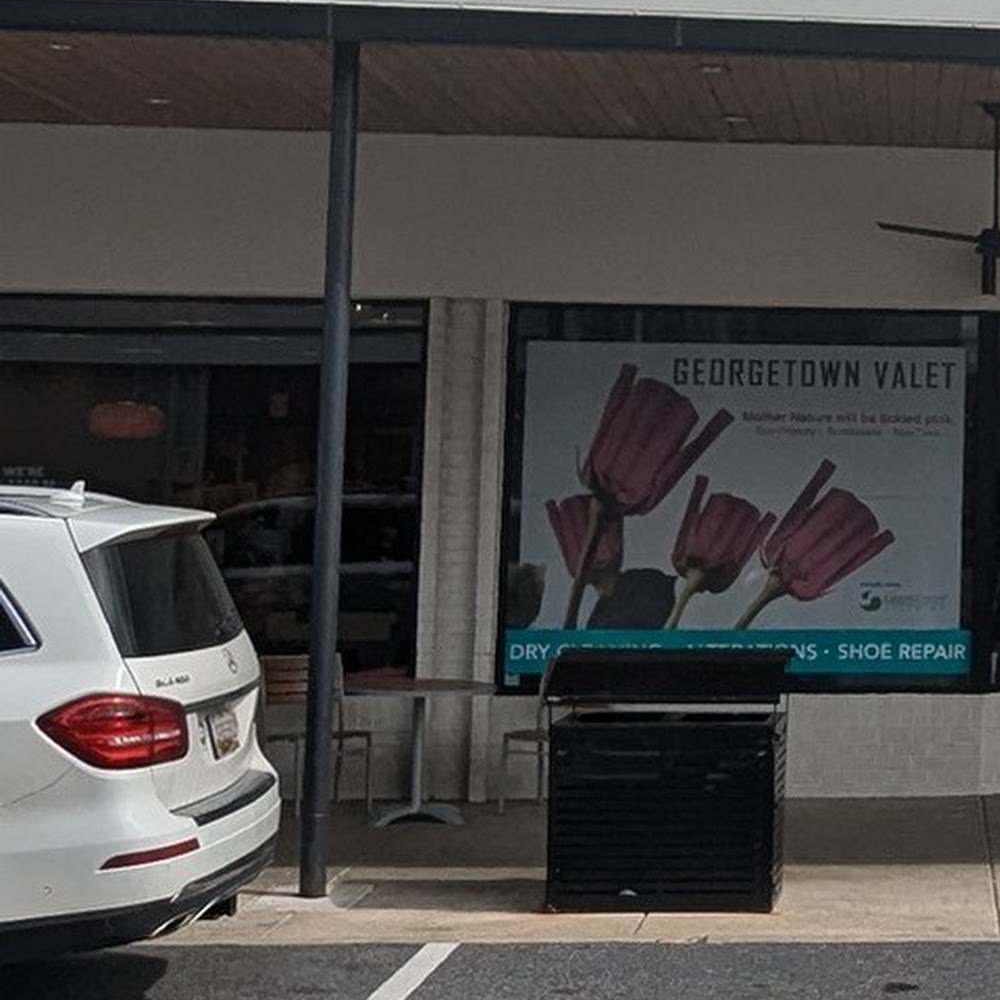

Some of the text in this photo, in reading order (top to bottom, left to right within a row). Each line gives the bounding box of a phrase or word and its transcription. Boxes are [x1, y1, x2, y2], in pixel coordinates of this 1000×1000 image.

[673, 357, 957, 390] GEORGETOWN VALET
[509, 643, 551, 661] DRY
[837, 643, 893, 661] SHOE
[898, 643, 967, 661] REPAIR
